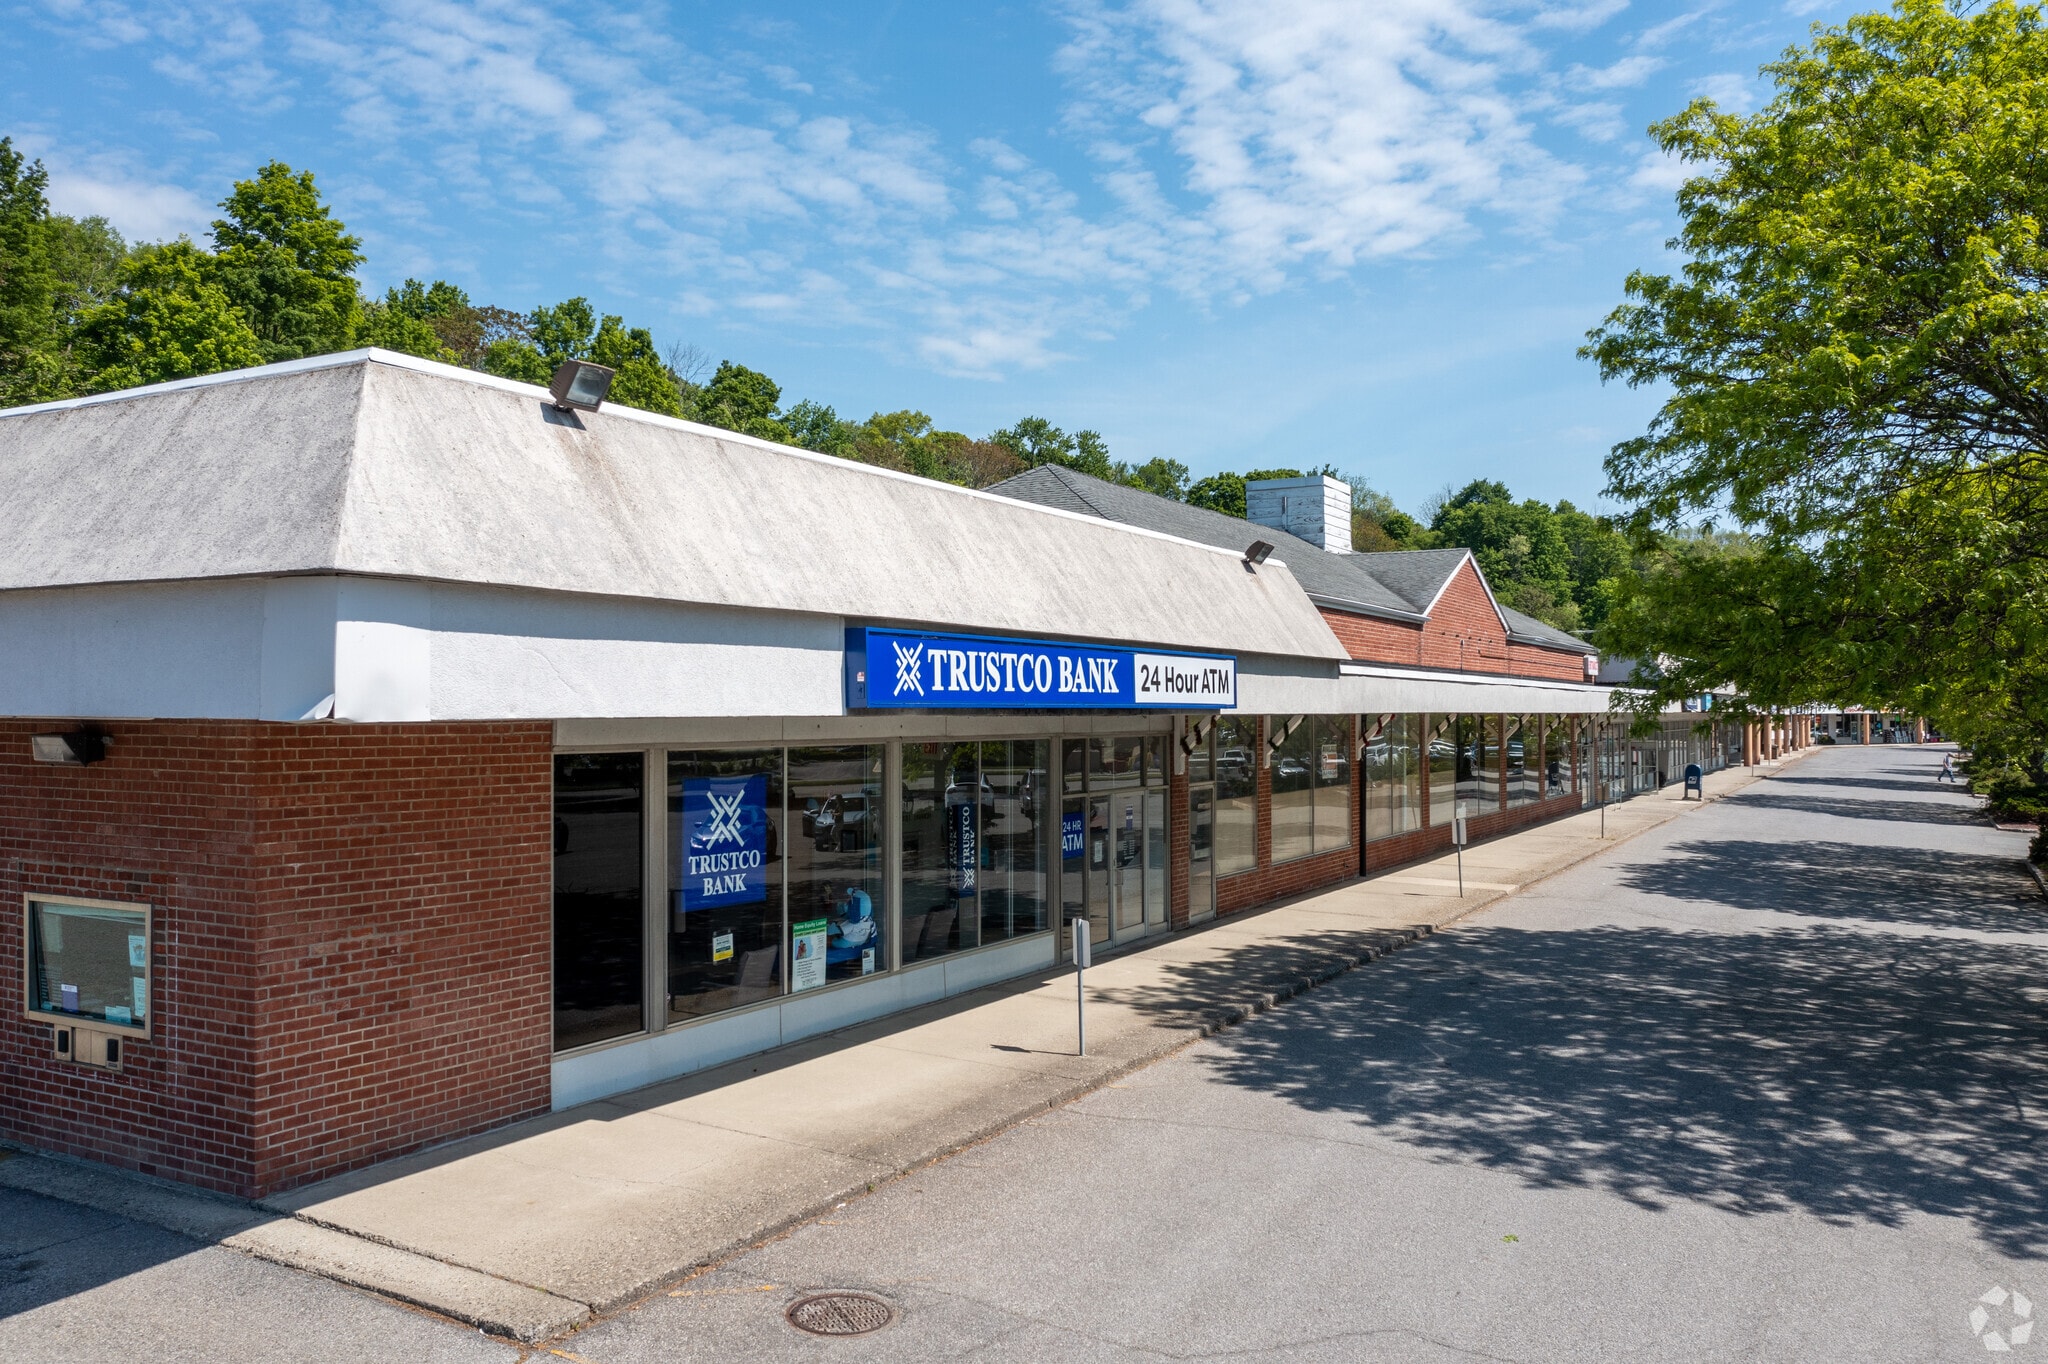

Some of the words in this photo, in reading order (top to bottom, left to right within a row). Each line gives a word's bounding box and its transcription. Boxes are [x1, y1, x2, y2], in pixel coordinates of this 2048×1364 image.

[928, 648, 1053, 693] TRUSTCO
[1058, 656, 1119, 694] BANK
[1140, 664, 1161, 692] 24
[1165, 666, 1199, 694] Hour
[1201, 667, 1230, 695] ATM
[962, 806, 970, 865] TRUSTCO
[1062, 821, 1071, 832] 24
[1072, 820, 1082, 831] HR
[1062, 833, 1083, 851] ATM
[688, 849, 760, 875] TRUSTCO
[702, 873, 747, 897] BANK
